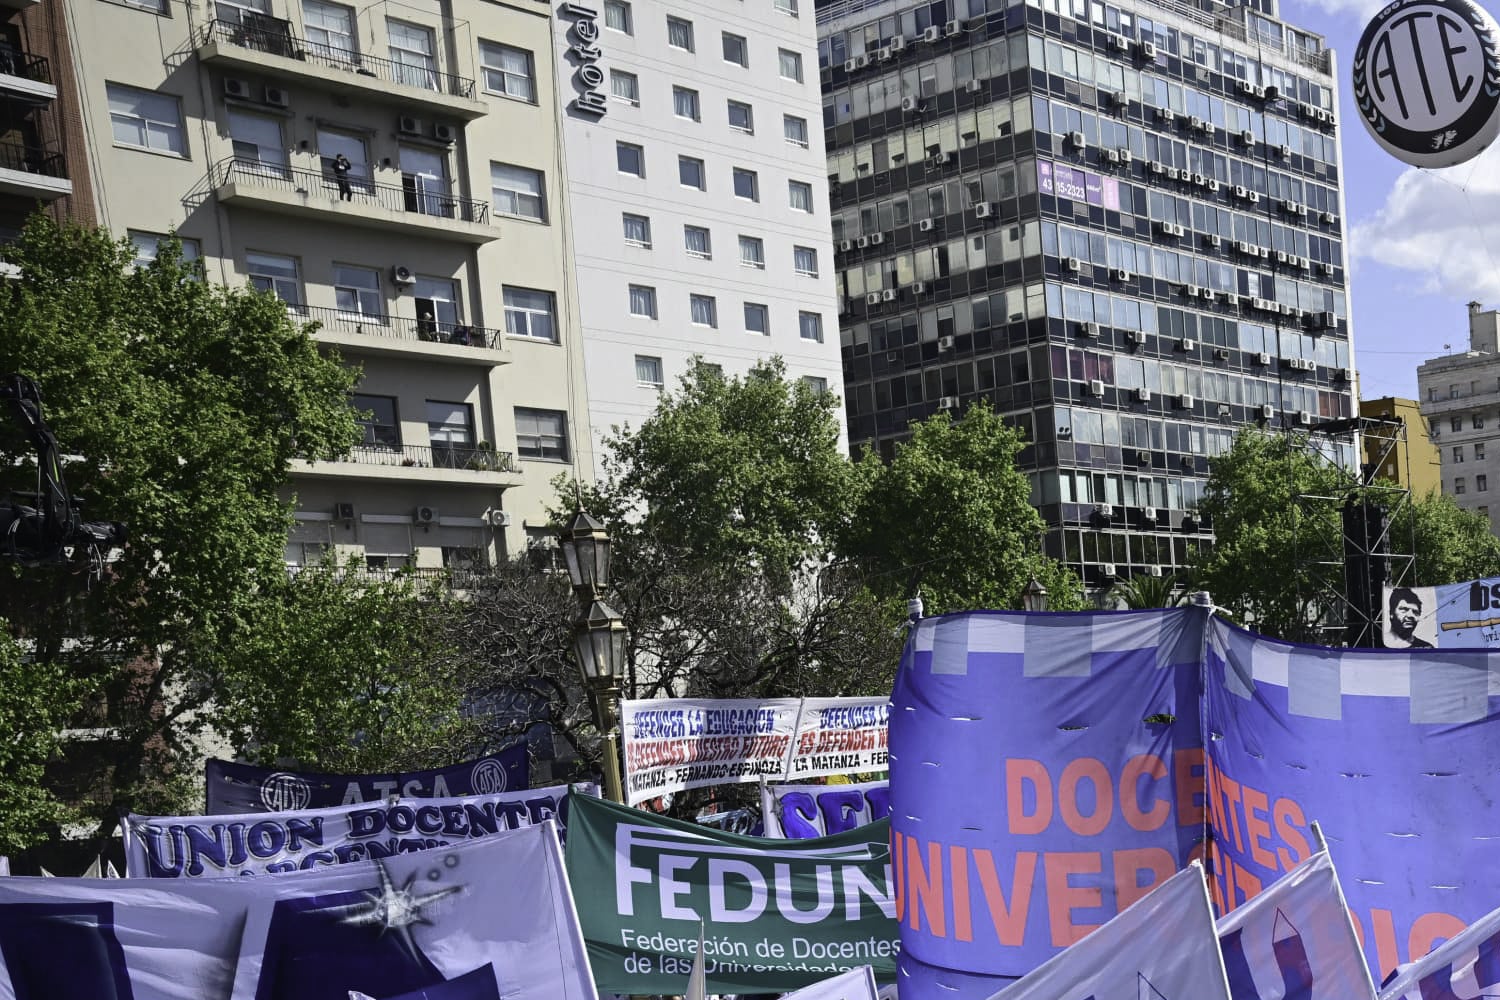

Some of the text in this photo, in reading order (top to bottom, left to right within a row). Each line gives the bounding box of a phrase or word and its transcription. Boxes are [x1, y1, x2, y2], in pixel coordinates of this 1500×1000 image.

[566, 2, 607, 115] hotel
[1372, 11, 1475, 121] ATE
[816, 729, 875, 752] DEFENDER
[819, 706, 876, 730] DEFENDER
[811, 752, 861, 771] MATANZA
[1006, 748, 1312, 874] DOCENTES
[147, 816, 324, 878] UNION
[616, 822, 897, 924] FEDUN
[620, 928, 902, 959] Federación de Docentes
[623, 951, 652, 974] de
[659, 953, 691, 975] las
